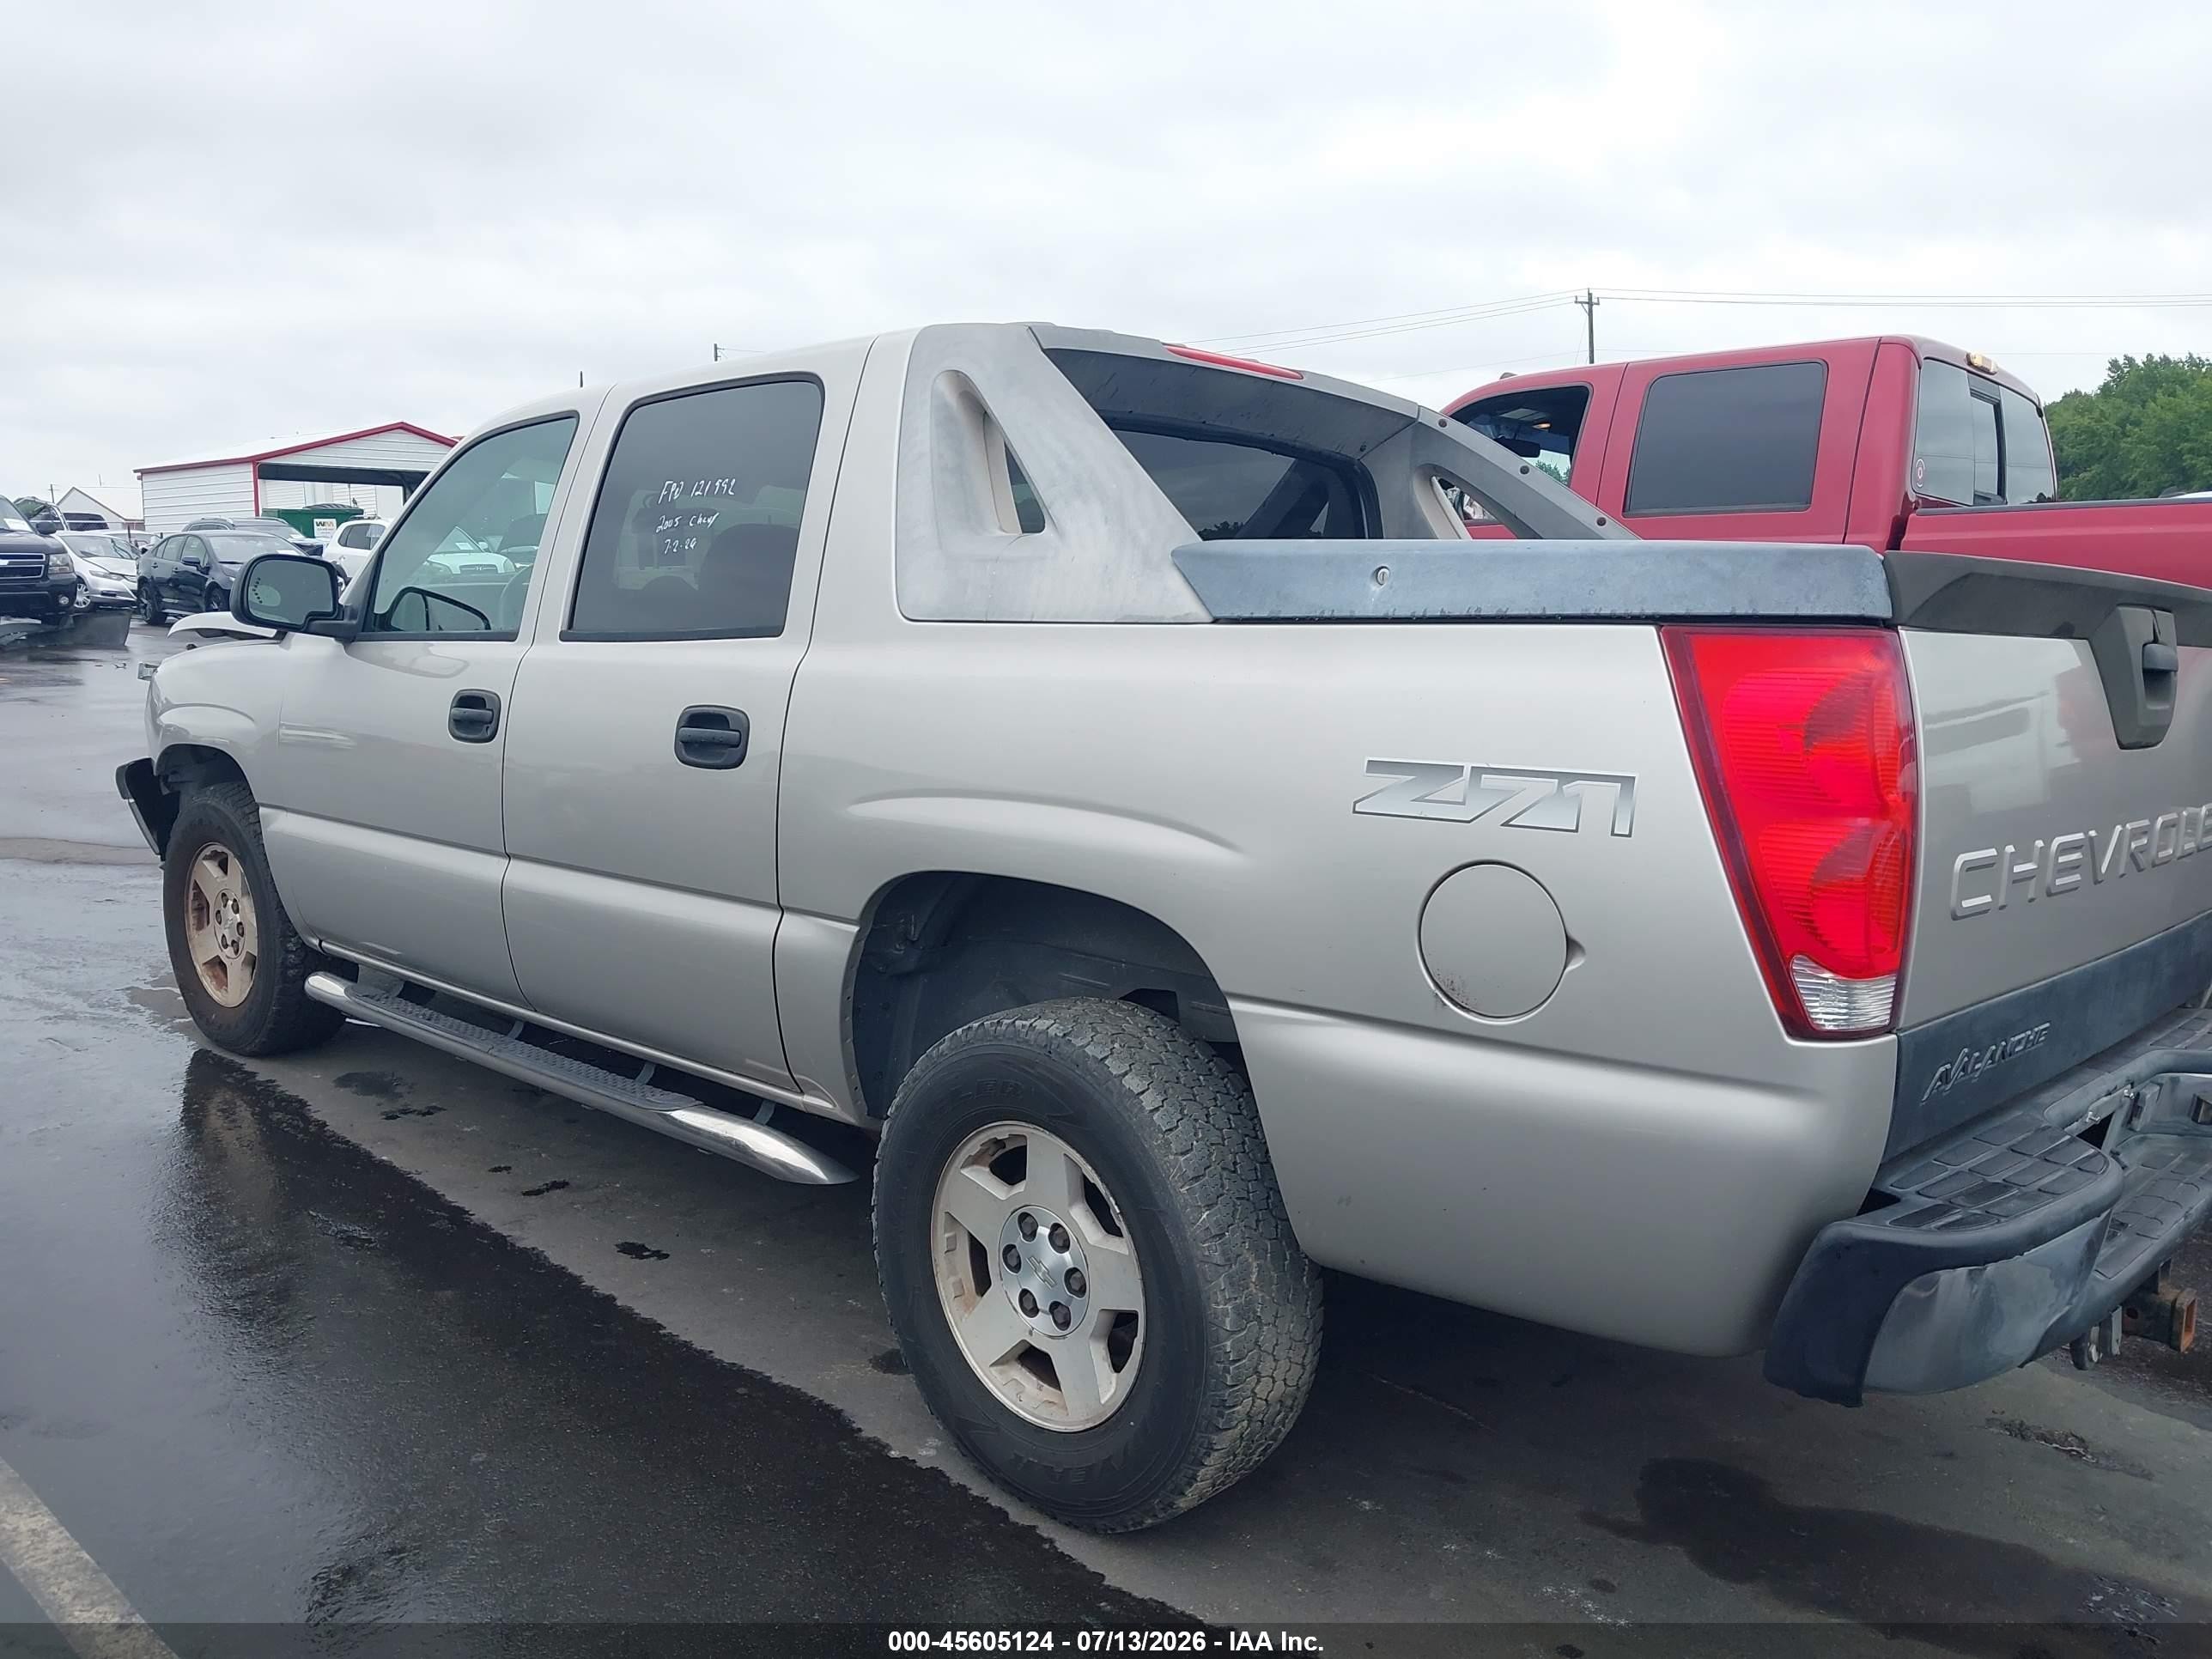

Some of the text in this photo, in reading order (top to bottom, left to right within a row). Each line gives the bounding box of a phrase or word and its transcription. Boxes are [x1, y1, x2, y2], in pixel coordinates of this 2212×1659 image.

[655, 515, 683, 533] 2005
[1352, 757, 1638, 838] Z71
[1920, 1022, 2051, 1106] AVALANCHE
